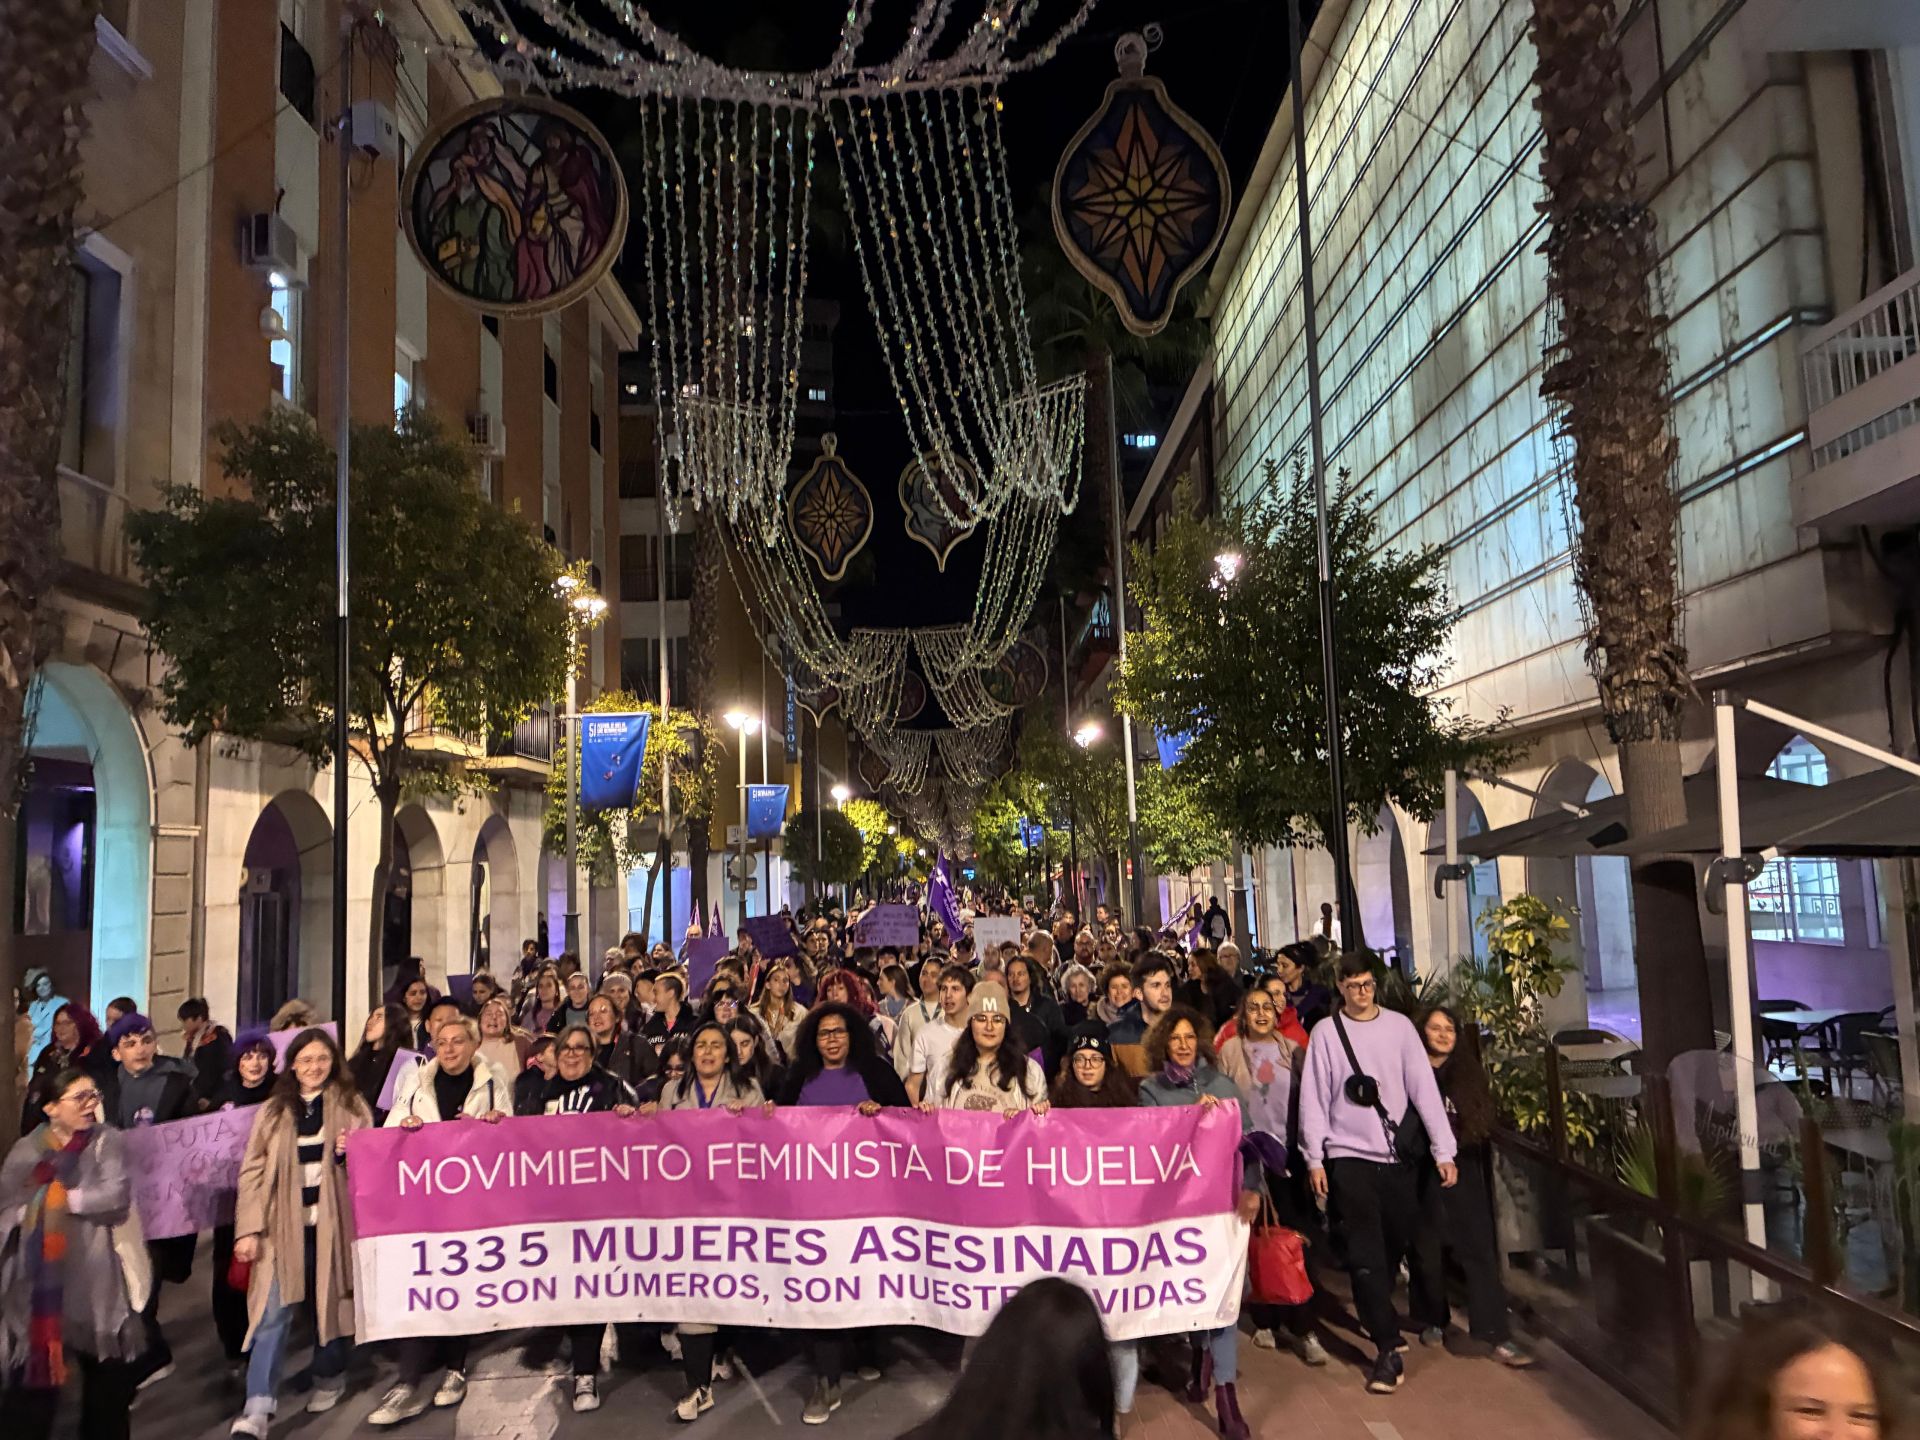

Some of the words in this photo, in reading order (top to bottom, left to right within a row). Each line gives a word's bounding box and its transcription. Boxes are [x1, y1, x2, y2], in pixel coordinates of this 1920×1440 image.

[982, 997, 998, 1012] M
[161, 1117, 237, 1154] PUTA
[398, 1144, 691, 1196] MOVIMIENTO
[708, 1141, 934, 1181] FEMINISTA
[945, 1146, 1005, 1188] DE
[1026, 1143, 1202, 1187] HUELVA
[412, 1230, 549, 1277] 1335
[572, 1225, 827, 1266] MUJERES
[850, 1225, 1208, 1276] ASESINADAS
[408, 1287, 460, 1312] NO
[475, 1276, 557, 1309] SON
[575, 1266, 769, 1306] NÚMEROS,
[783, 1275, 861, 1303] SON
[879, 1274, 1024, 1311] NUESTR
[1092, 1278, 1207, 1315] VIDAS
